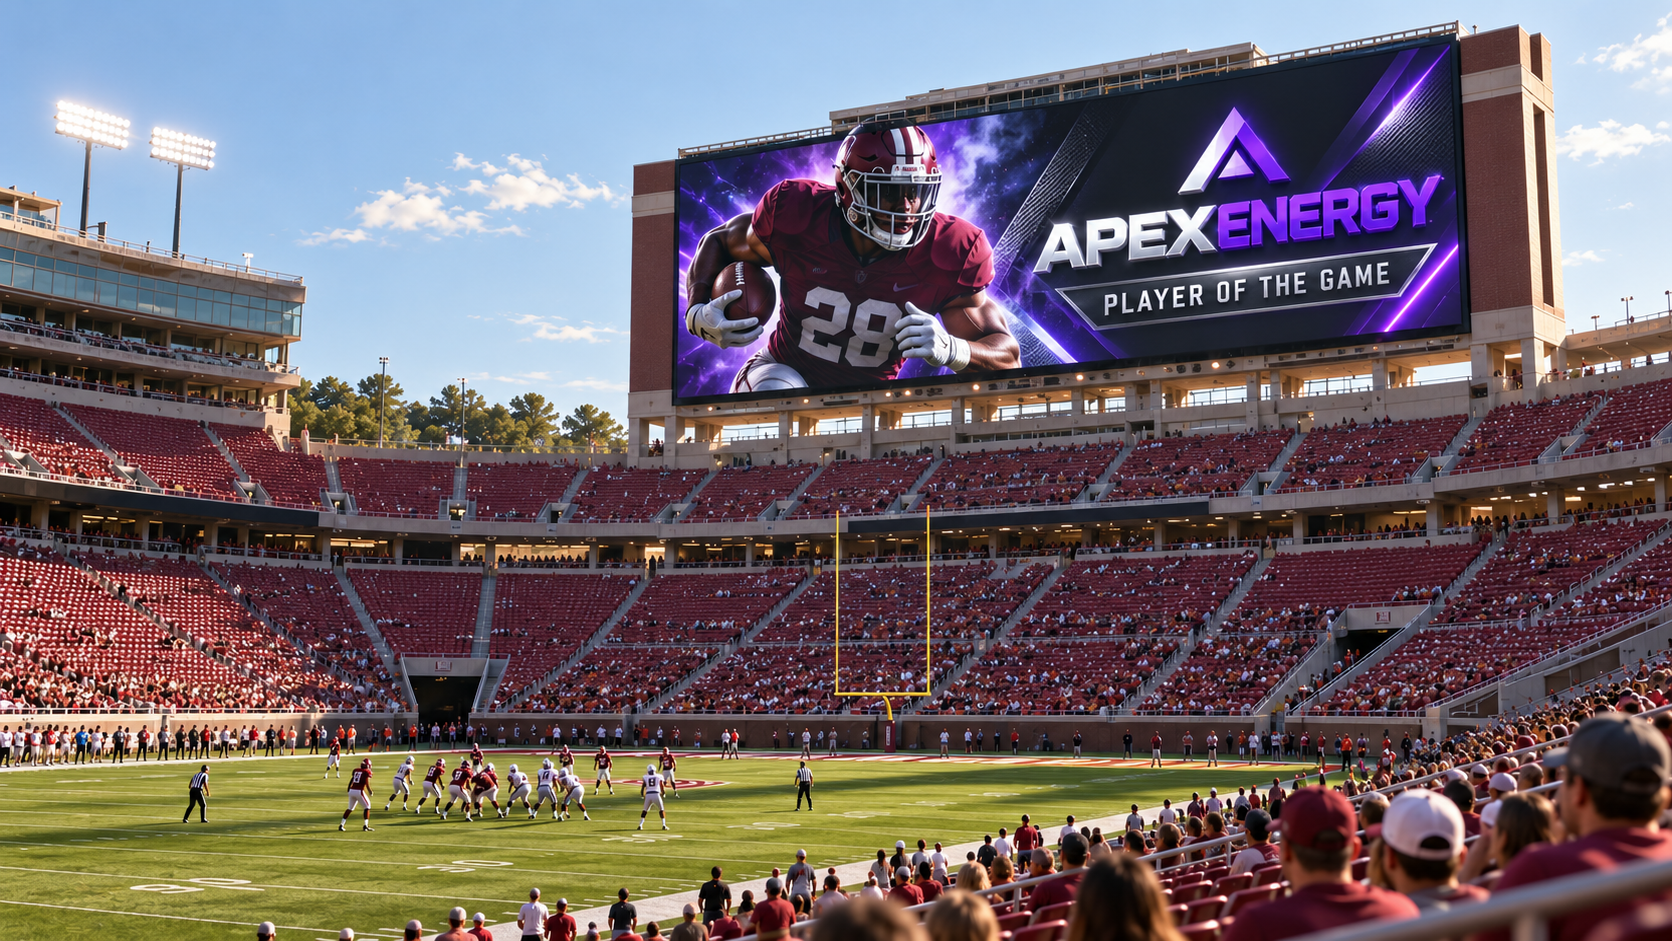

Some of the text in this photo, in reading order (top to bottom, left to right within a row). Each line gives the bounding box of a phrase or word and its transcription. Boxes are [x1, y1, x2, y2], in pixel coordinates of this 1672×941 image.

[1033, 175, 1442, 273] APEXENERGY
[798, 286, 903, 367] 28
[1104, 262, 1390, 316] PLAYER OF THE GAME
